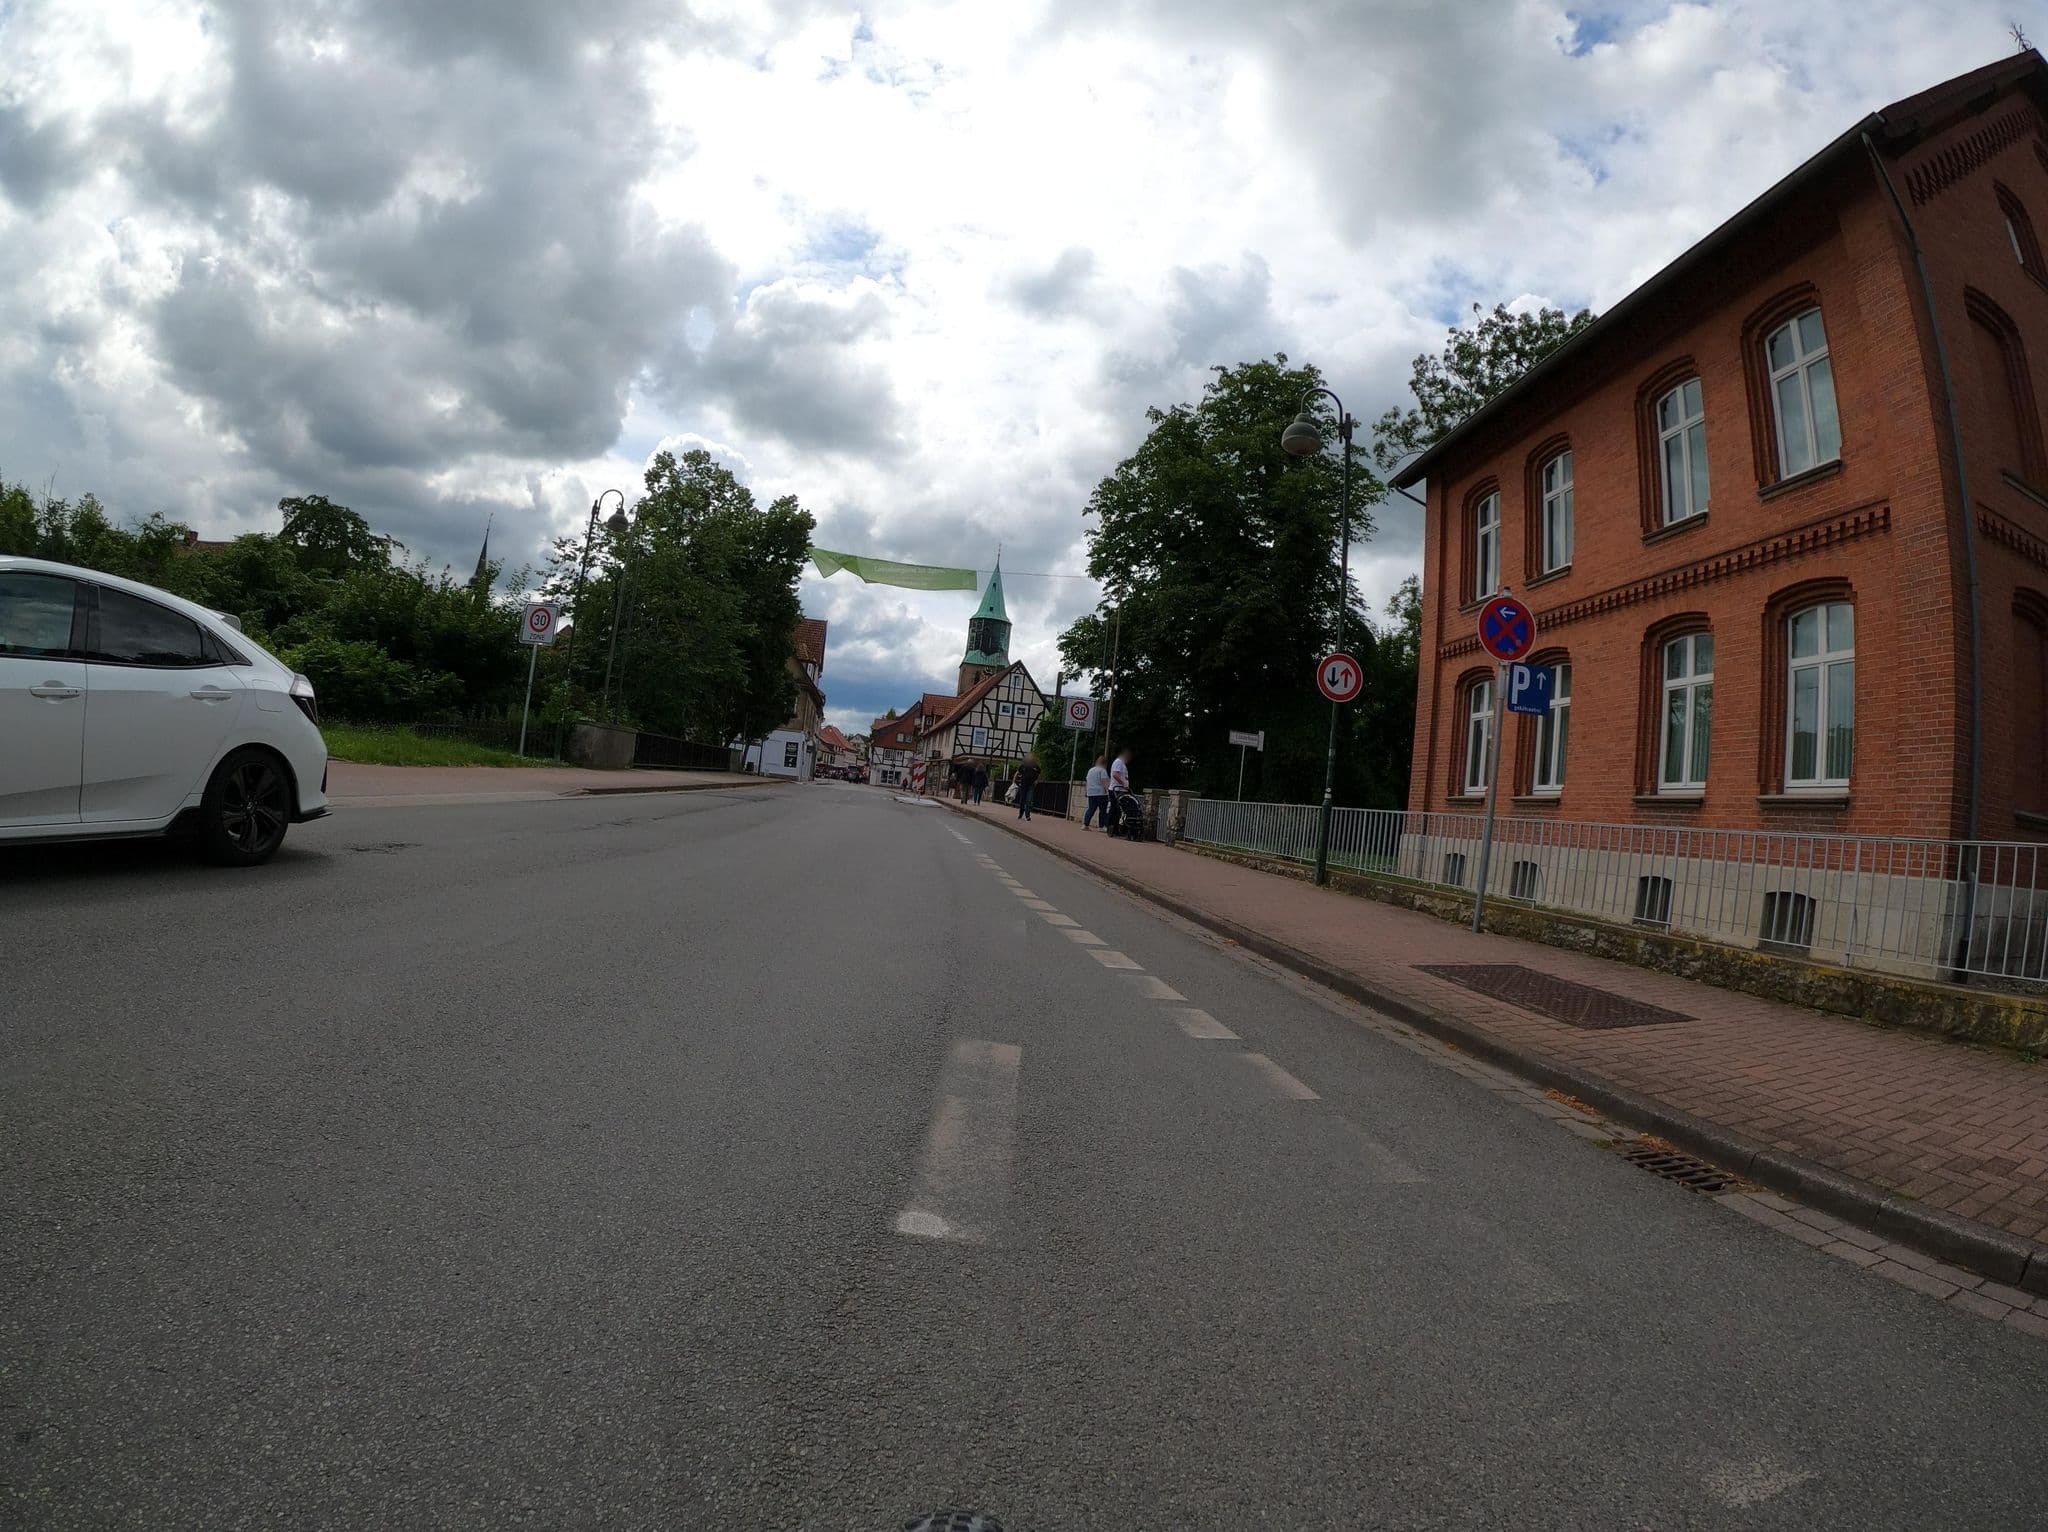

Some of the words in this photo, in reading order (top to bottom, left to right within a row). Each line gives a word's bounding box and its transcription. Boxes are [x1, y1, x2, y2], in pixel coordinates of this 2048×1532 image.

[534, 614, 547, 626] 30
[1511, 665, 1530, 704] P
[1074, 706, 1086, 716] 30
